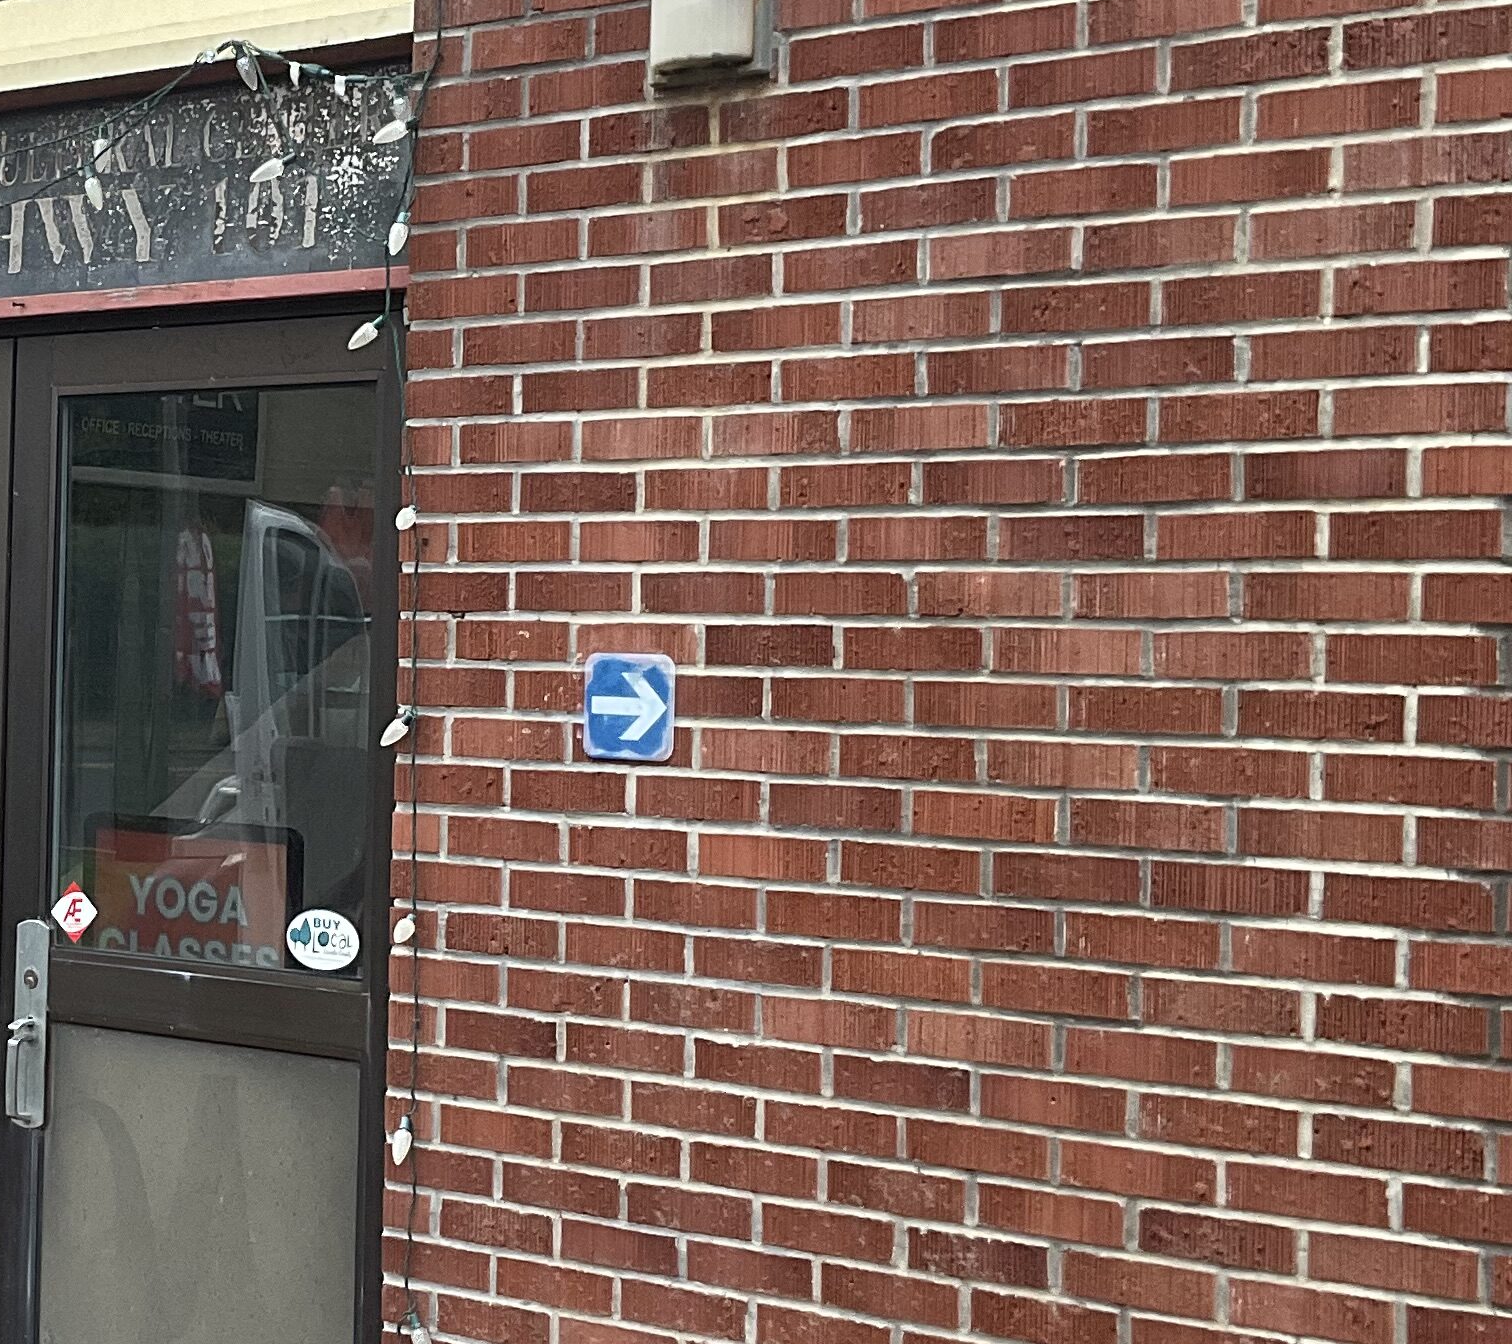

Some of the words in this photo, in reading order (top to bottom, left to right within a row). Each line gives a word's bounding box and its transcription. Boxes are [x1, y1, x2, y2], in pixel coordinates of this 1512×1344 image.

[81, 417, 120, 435] OFFICE
[200, 429, 244, 448] THEATER
[129, 874, 249, 927] YOGA
[313, 917, 341, 930] BUY
